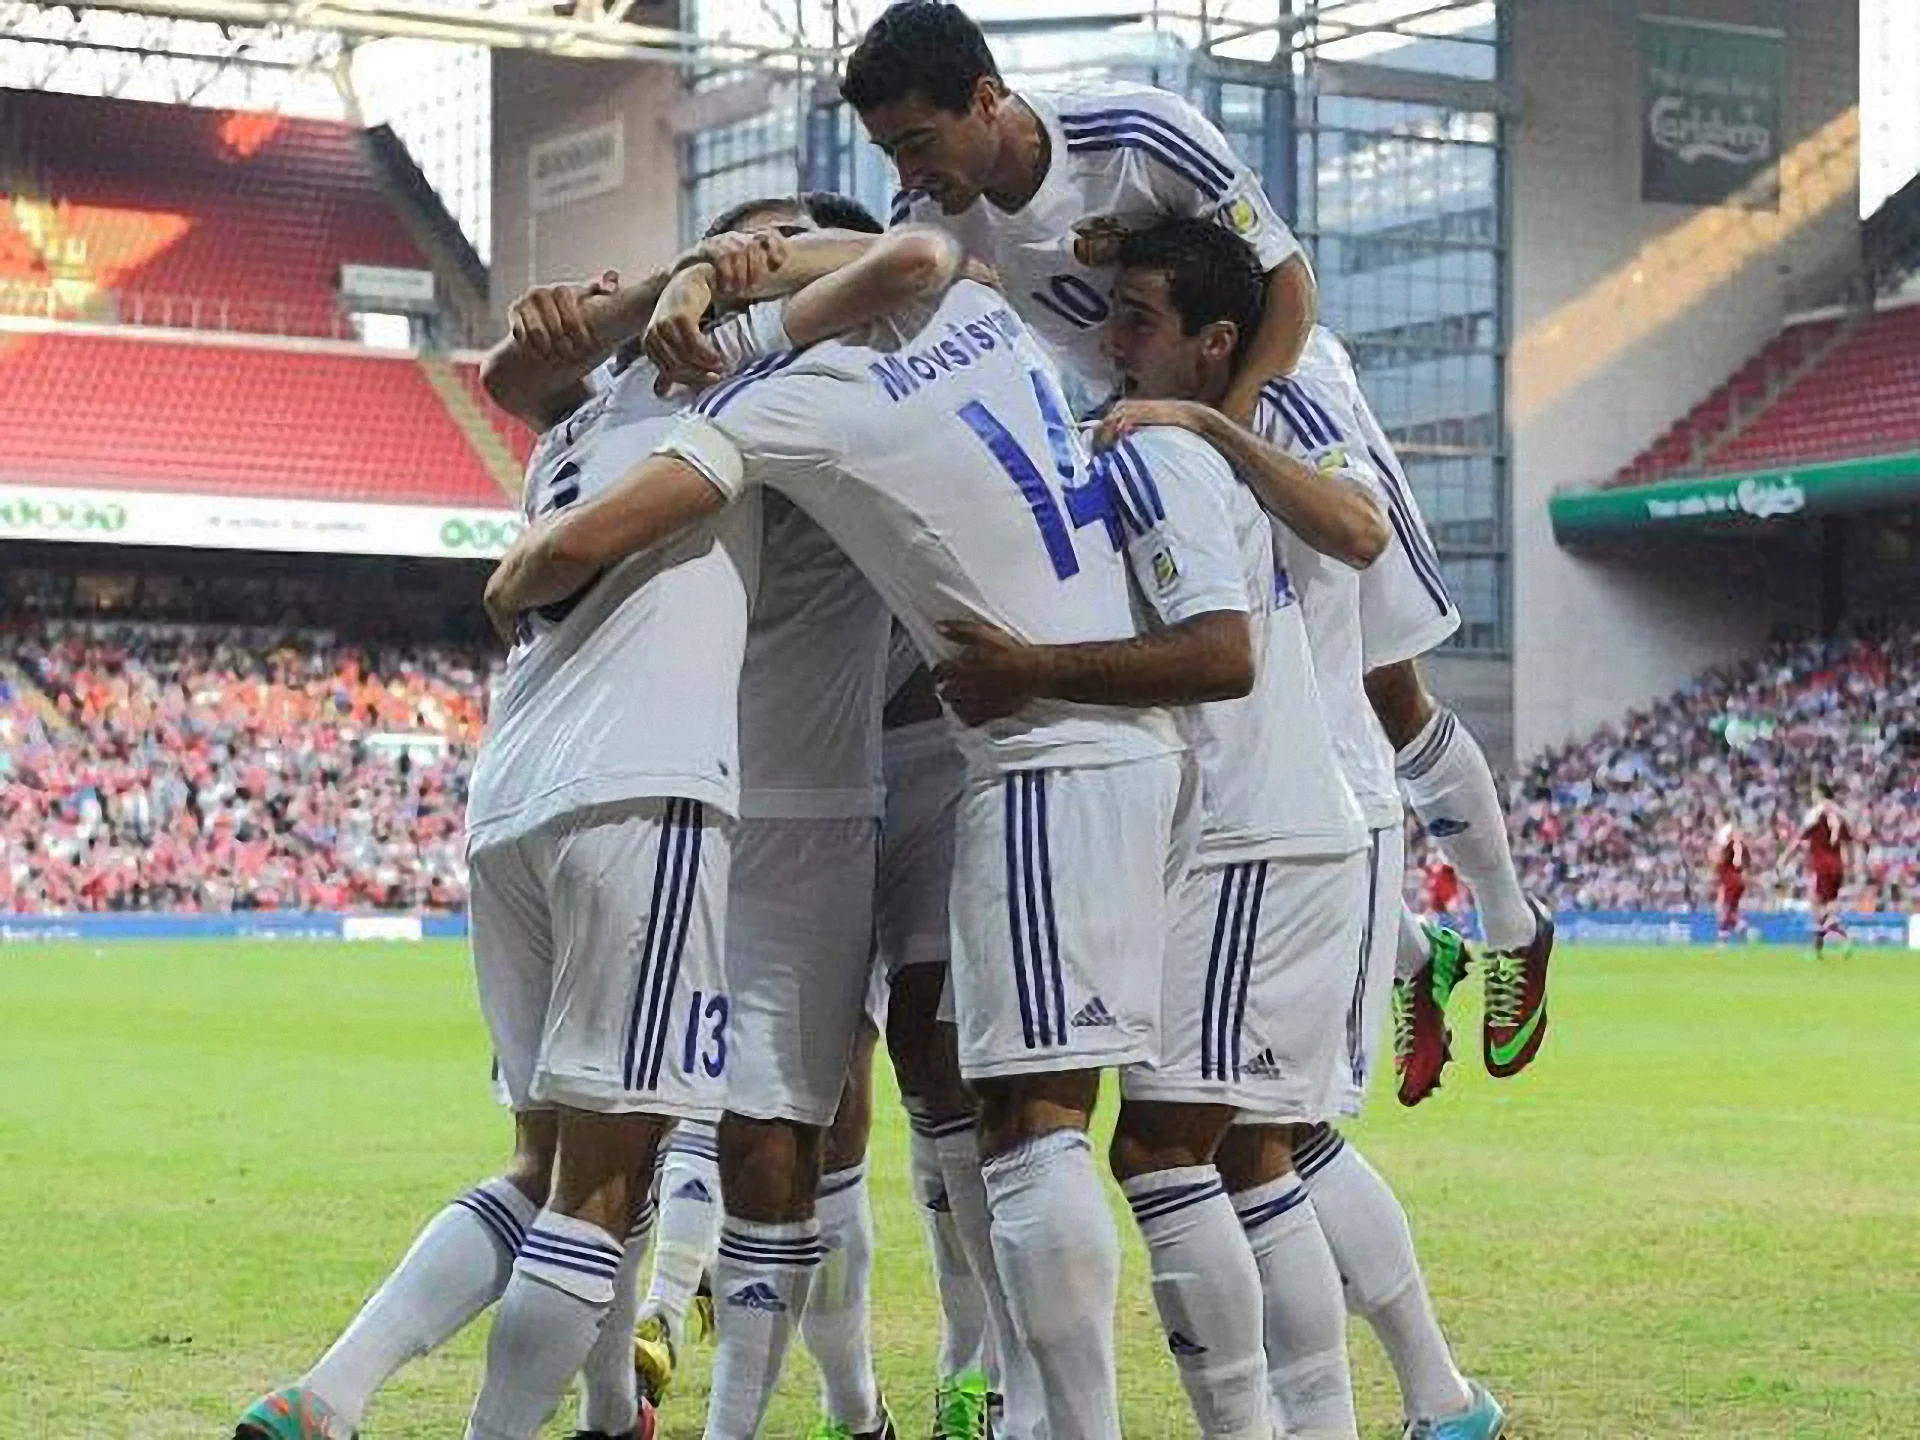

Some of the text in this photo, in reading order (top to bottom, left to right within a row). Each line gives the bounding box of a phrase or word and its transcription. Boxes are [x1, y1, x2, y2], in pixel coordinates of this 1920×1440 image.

[868, 310, 1021, 402] Movsisy
[957, 368, 1127, 581] 14
[683, 990, 728, 1078] 13
